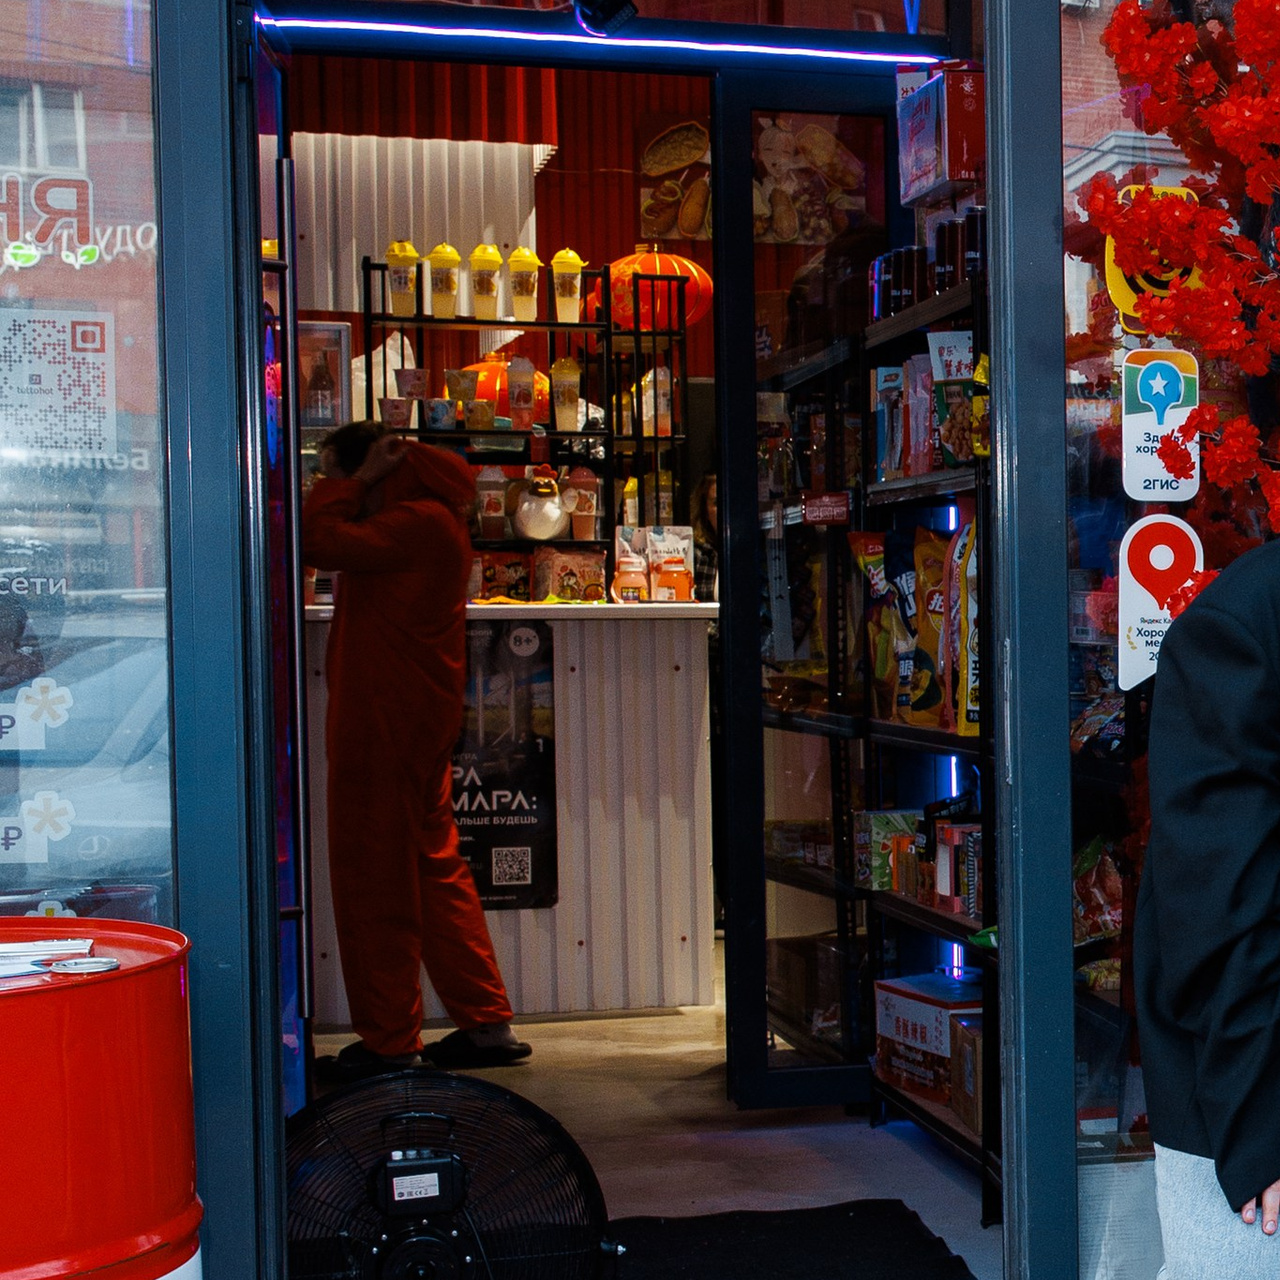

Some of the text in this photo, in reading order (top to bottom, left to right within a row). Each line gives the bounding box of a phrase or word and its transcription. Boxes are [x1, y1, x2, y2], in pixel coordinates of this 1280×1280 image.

[1143, 478, 1180, 490] 2ГИС
[1140, 617, 1162, 625] Яндекс
[1136, 627, 1166, 639] Хоро
[1145, 640, 1160, 648] ме
[492, 815, 538, 826] БУДЕШЬ
